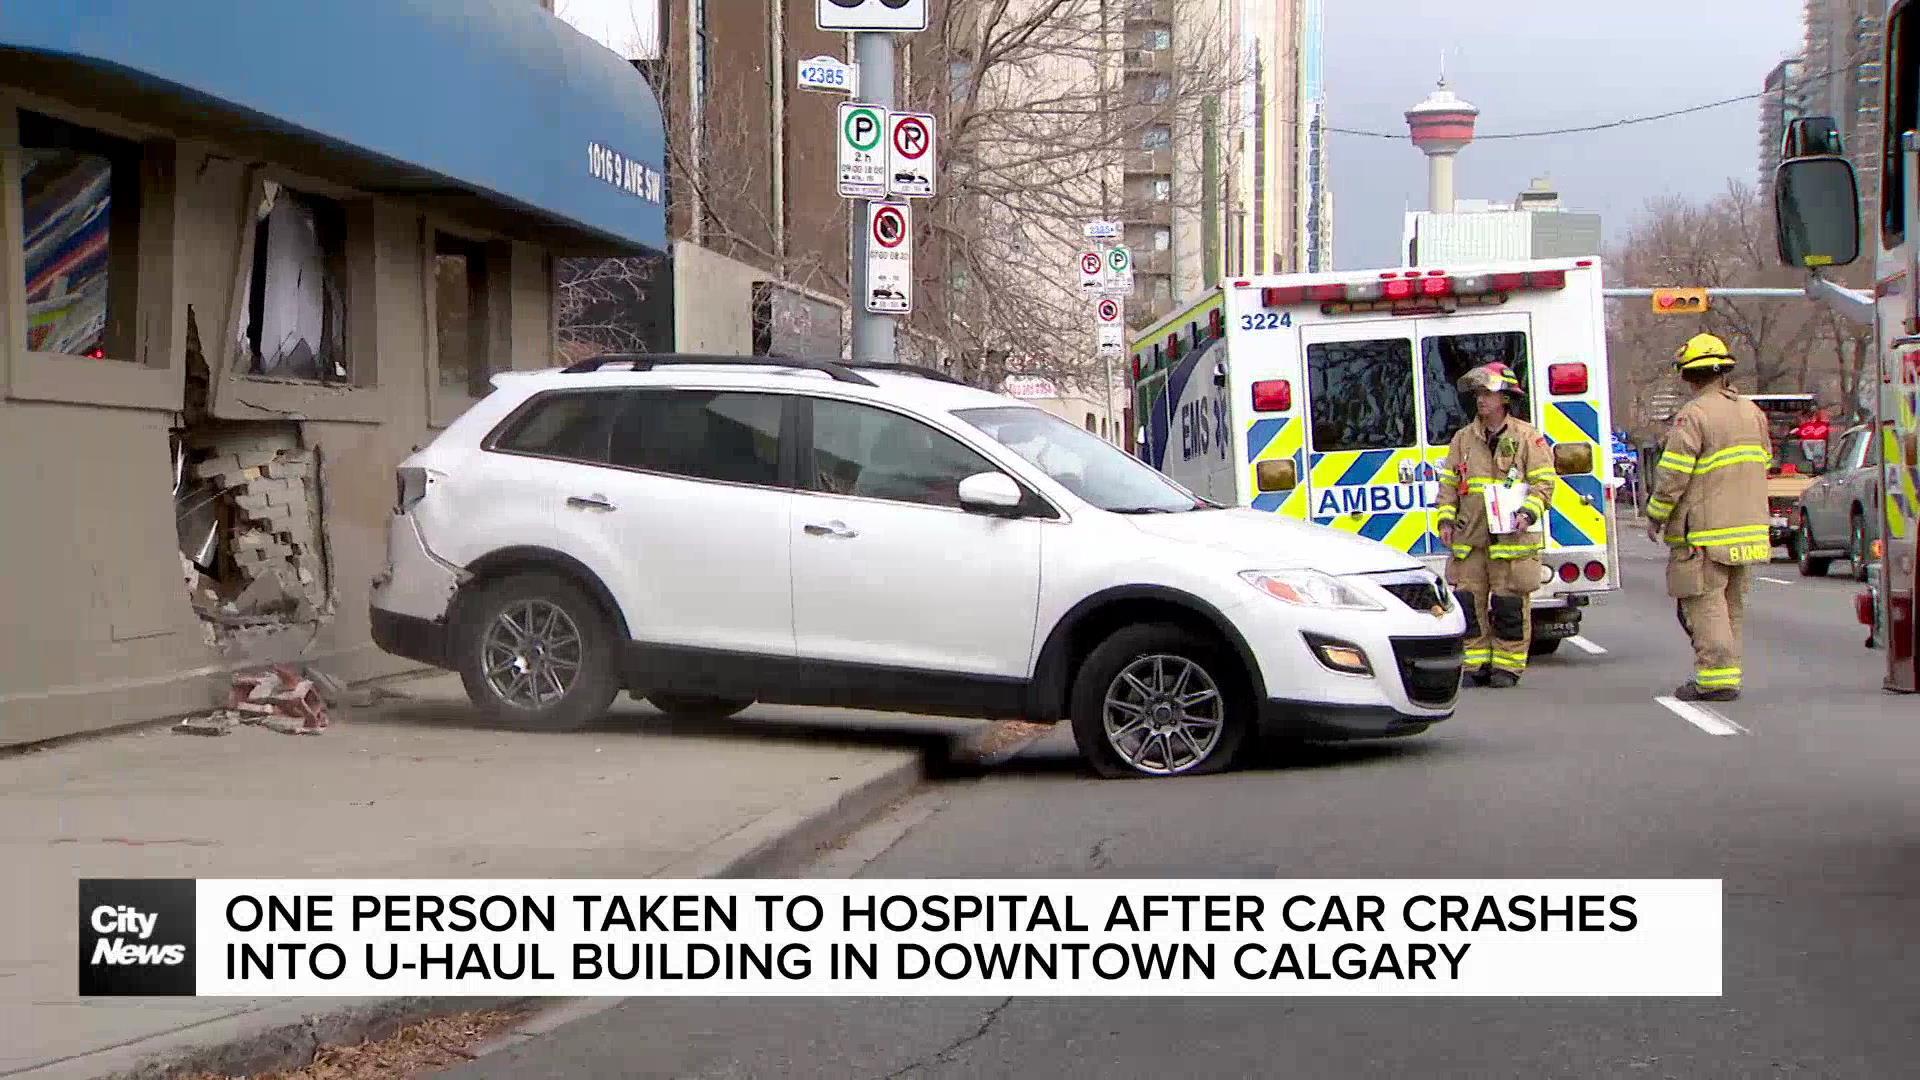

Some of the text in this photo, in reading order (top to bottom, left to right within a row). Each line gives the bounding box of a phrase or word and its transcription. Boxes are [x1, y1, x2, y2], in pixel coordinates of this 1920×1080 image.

[808, 67, 844, 85] 2385
[588, 141, 660, 204] 1016 9 AVE SW
[1241, 312, 1292, 330] 3224
[1182, 395, 1209, 461] EMS
